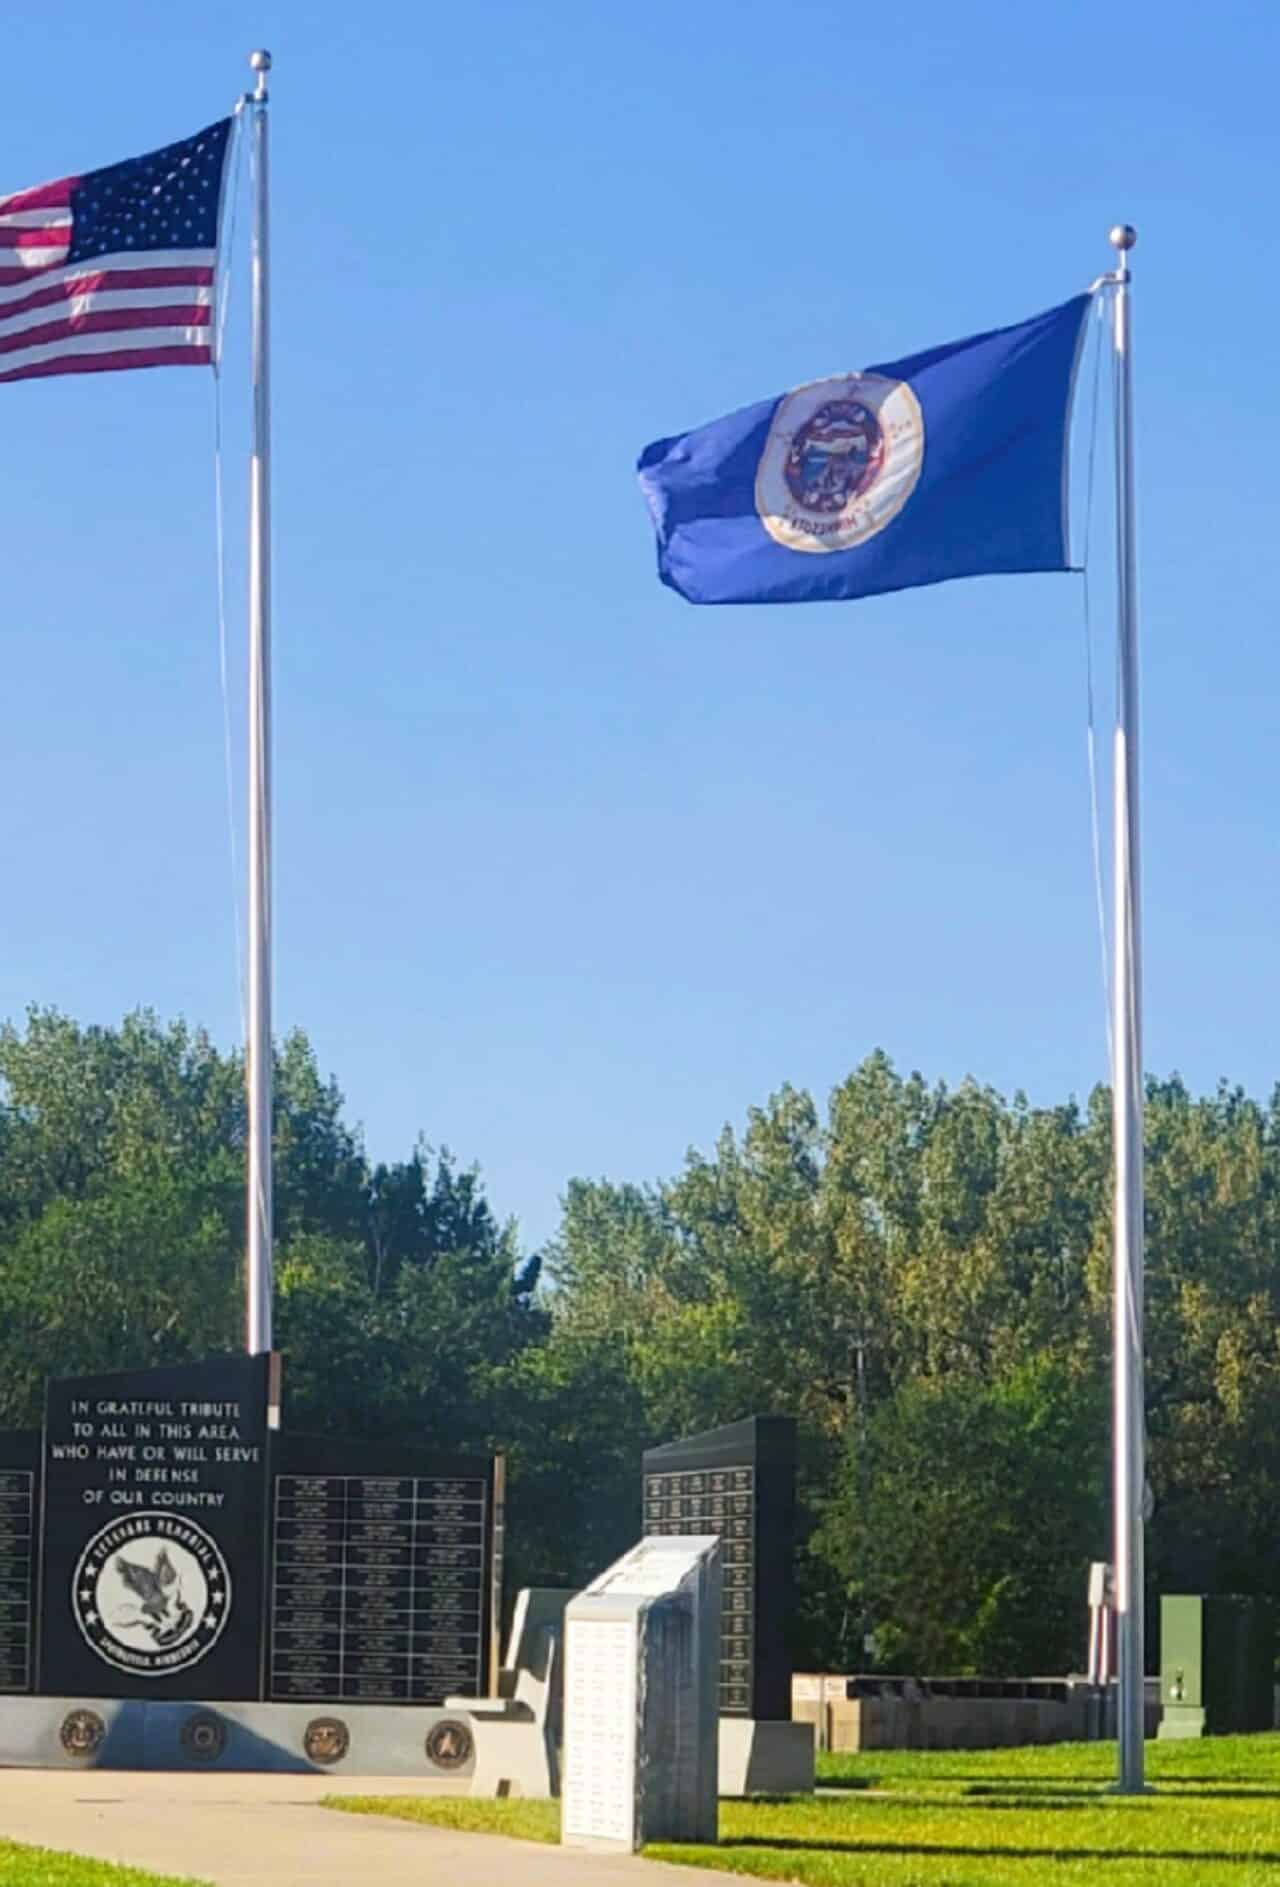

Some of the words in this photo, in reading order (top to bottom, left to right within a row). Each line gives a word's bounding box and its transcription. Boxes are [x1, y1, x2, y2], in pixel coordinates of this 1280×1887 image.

[71, 1400, 89, 1415] IN
[97, 1401, 173, 1416] GRATEFUL
[181, 1402, 240, 1418] TRIBUTE
[72, 1422, 94, 1437] TO
[100, 1423, 127, 1438] ALL
[135, 1424, 151, 1438] IN
[159, 1424, 191, 1439] THIS
[198, 1425, 240, 1440] AREA
[51, 1444, 89, 1459] WHO
[97, 1445, 136, 1460] HAVE
[143, 1446, 166, 1461] OR
[174, 1446, 208, 1462] WILL
[215, 1447, 260, 1463] SERVE
[109, 1468, 127, 1481] IN
[135, 1469, 199, 1483] DEFENSE
[82, 1490, 104, 1504] OF
[109, 1490, 143, 1505] OUR
[151, 1491, 225, 1506] COUNTRY
